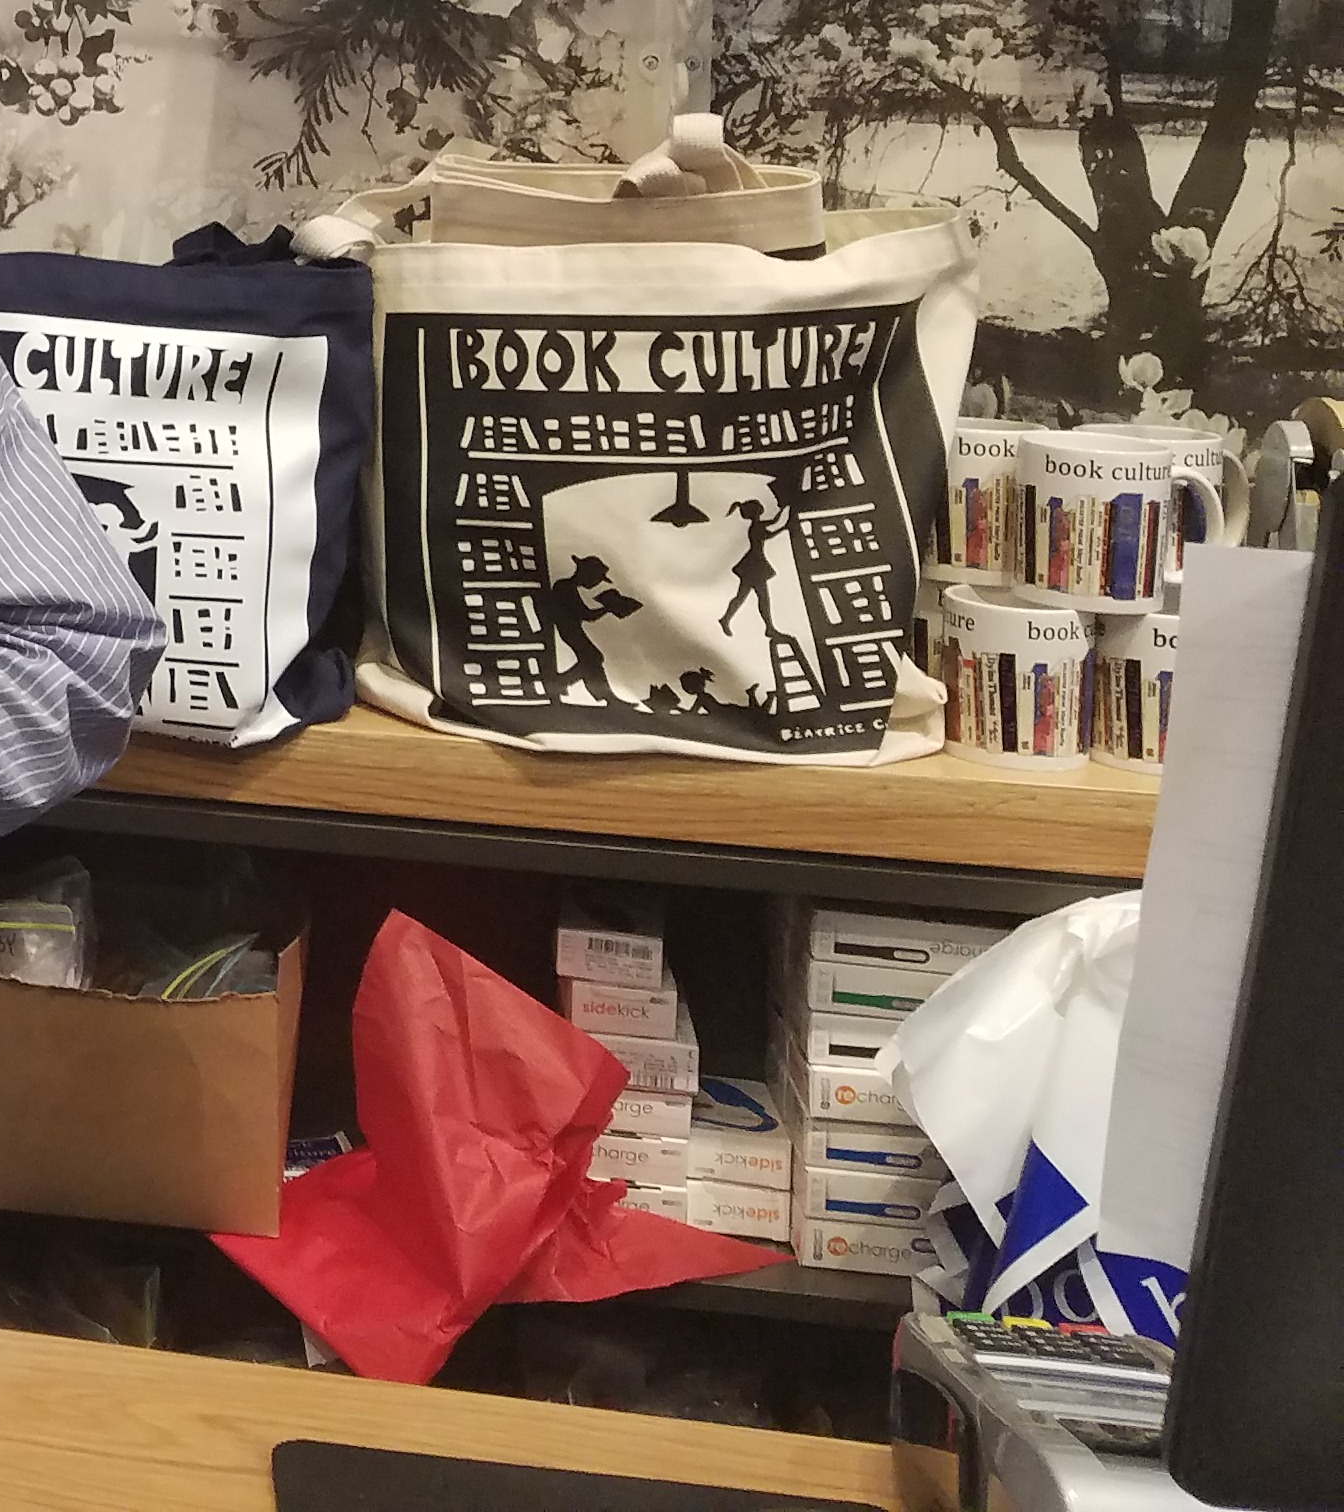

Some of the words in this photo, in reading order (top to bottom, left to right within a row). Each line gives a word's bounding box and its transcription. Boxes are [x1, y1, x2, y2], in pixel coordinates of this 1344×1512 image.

[14, 331, 253, 404] CULTURE
[453, 328, 620, 392] BOOK
[649, 321, 876, 393] CULTURE
[958, 437, 1016, 458] book
[1044, 454, 1104, 480] book
[1111, 457, 1173, 483] cultur
[1028, 620, 1079, 641] book
[1153, 628, 1179, 649] bo
[583, 1001, 650, 1020] sidekick
[613, 1100, 654, 1118] arge
[594, 1144, 649, 1167] harge
[715, 1151, 783, 1171] sidekick
[713, 1203, 780, 1224] sidekick
